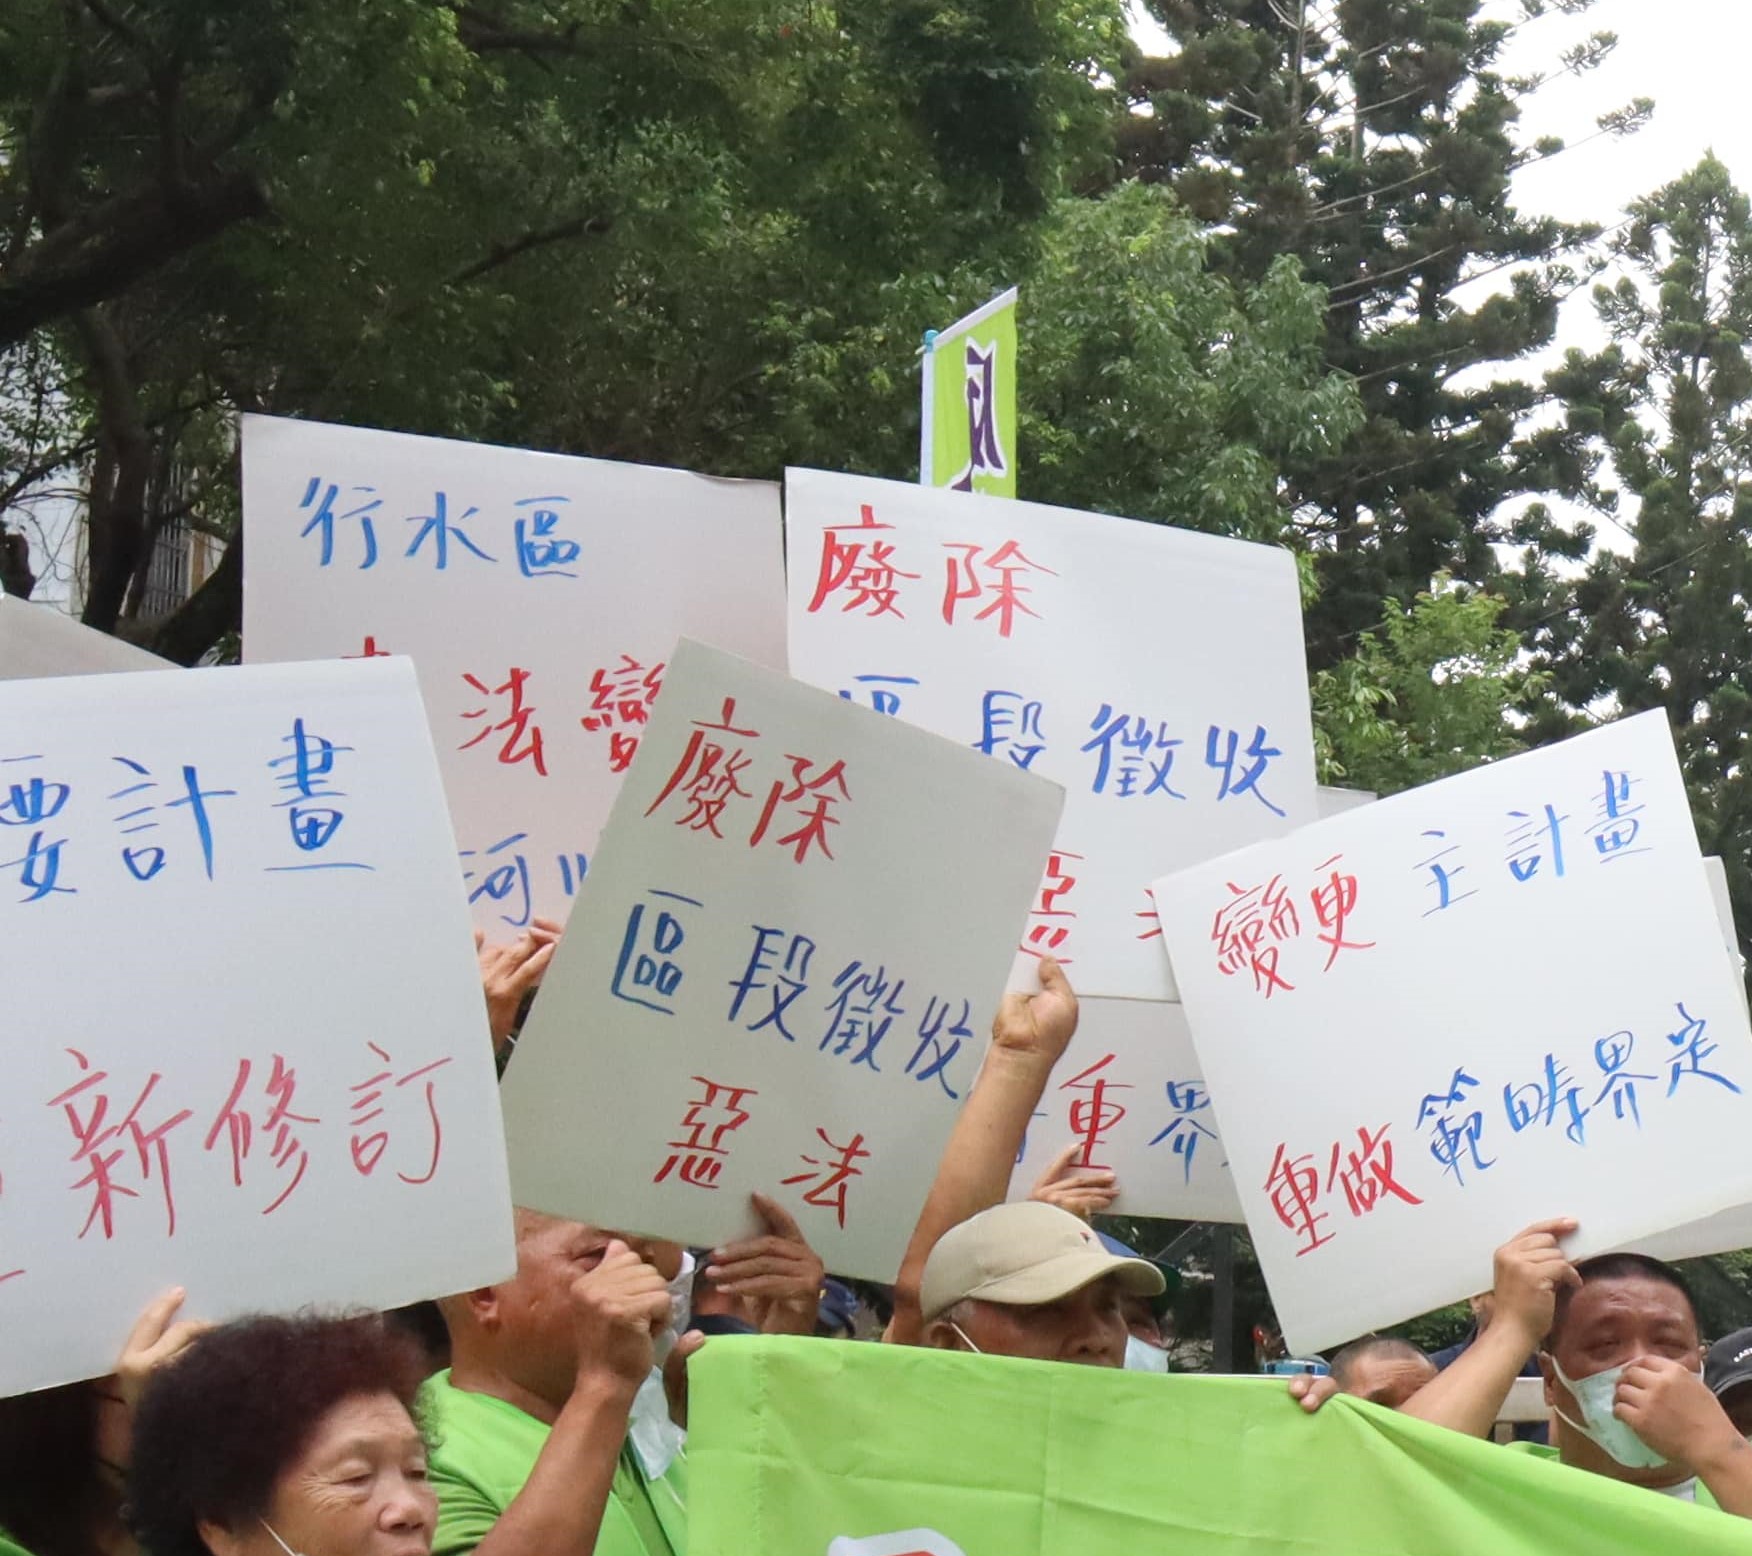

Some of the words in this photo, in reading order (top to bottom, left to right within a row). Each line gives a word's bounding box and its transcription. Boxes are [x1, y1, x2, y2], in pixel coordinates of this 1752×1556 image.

[301, 477, 584, 579] 行水區
[807, 504, 1060, 638] 廢除
[341, 636, 666, 778] 法變
[644, 697, 852, 864] 廢除
[0, 717, 376, 903] 要計畫
[611, 889, 975, 1100] 區段徵收
[0, 1041, 453, 1282] 新修訂
[653, 1076, 872, 1230] 惡法
